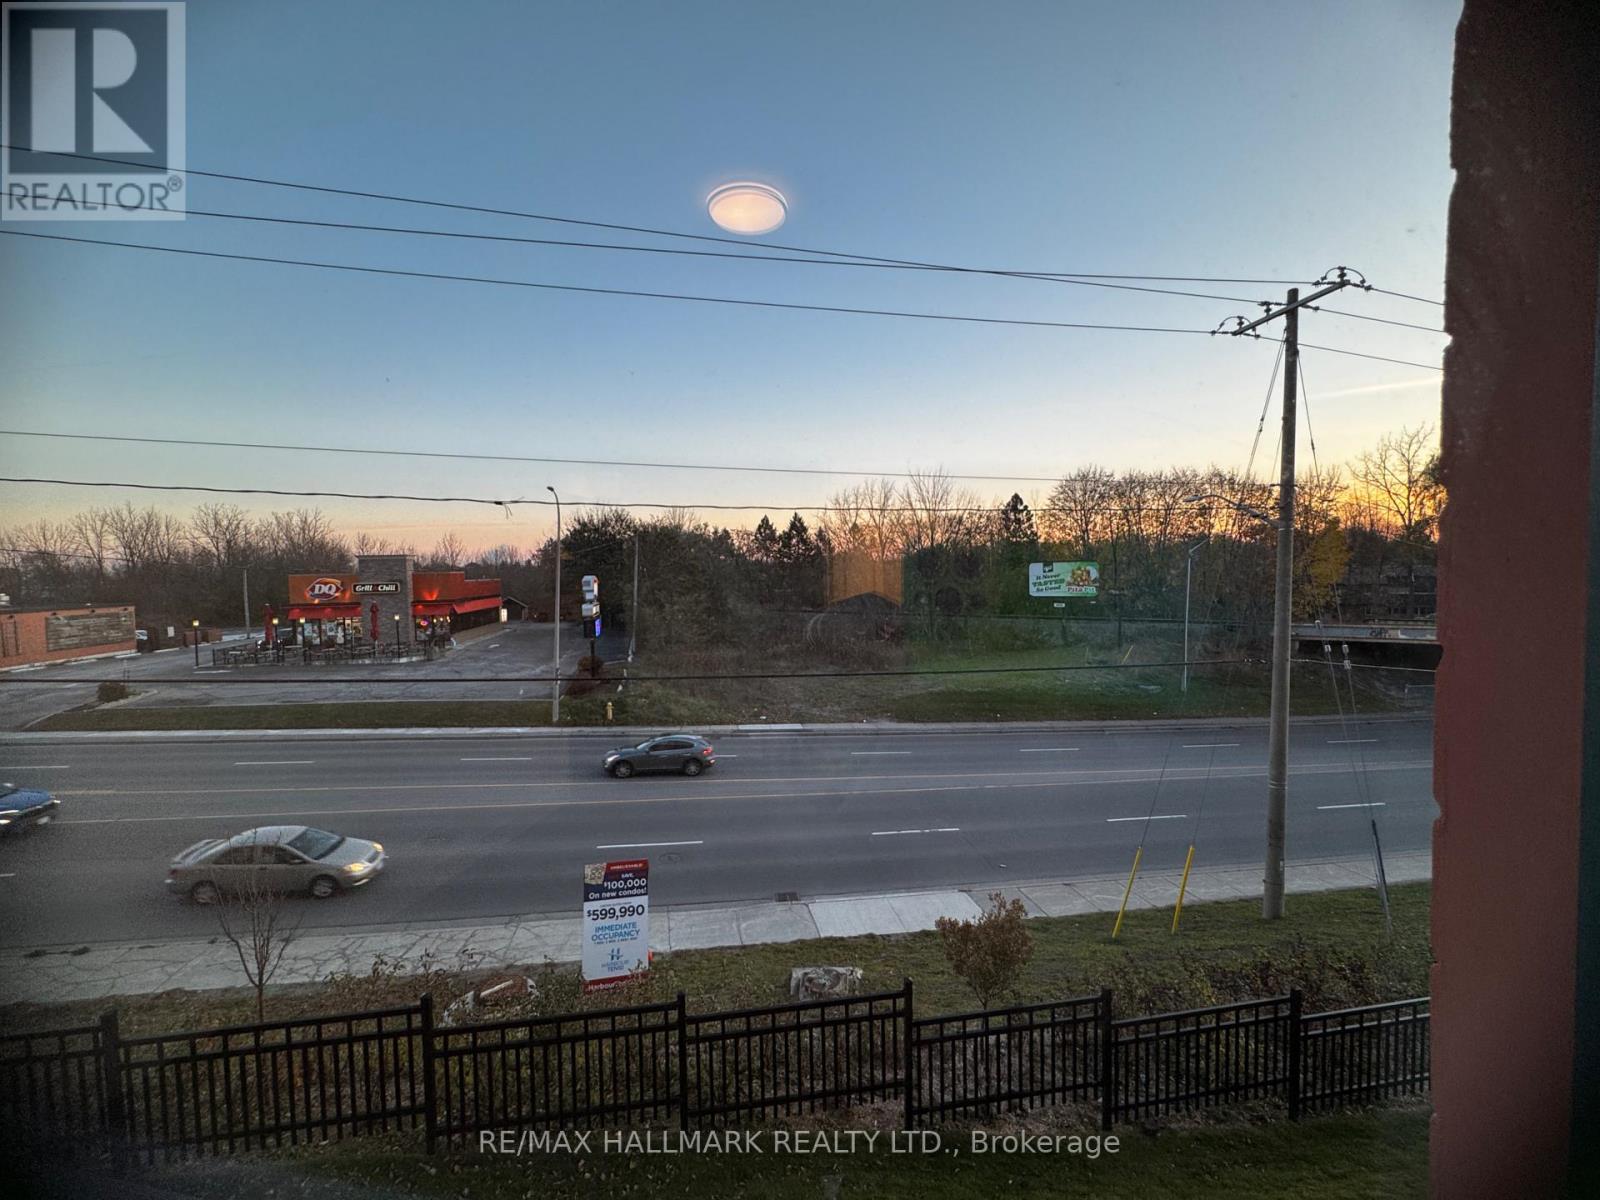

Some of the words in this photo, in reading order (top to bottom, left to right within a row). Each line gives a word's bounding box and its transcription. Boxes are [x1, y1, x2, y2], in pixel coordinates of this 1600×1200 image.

[314, 584, 337, 595] DQ
[378, 584, 396, 592] Chill
[604, 878, 647, 889] $100,000
[588, 892, 600, 900] On
[618, 887, 647, 896] condos!
[587, 904, 645, 921] $599,990
[594, 922, 638, 933] IMMEDIATE
[591, 929, 640, 941] OCCUPANCY
